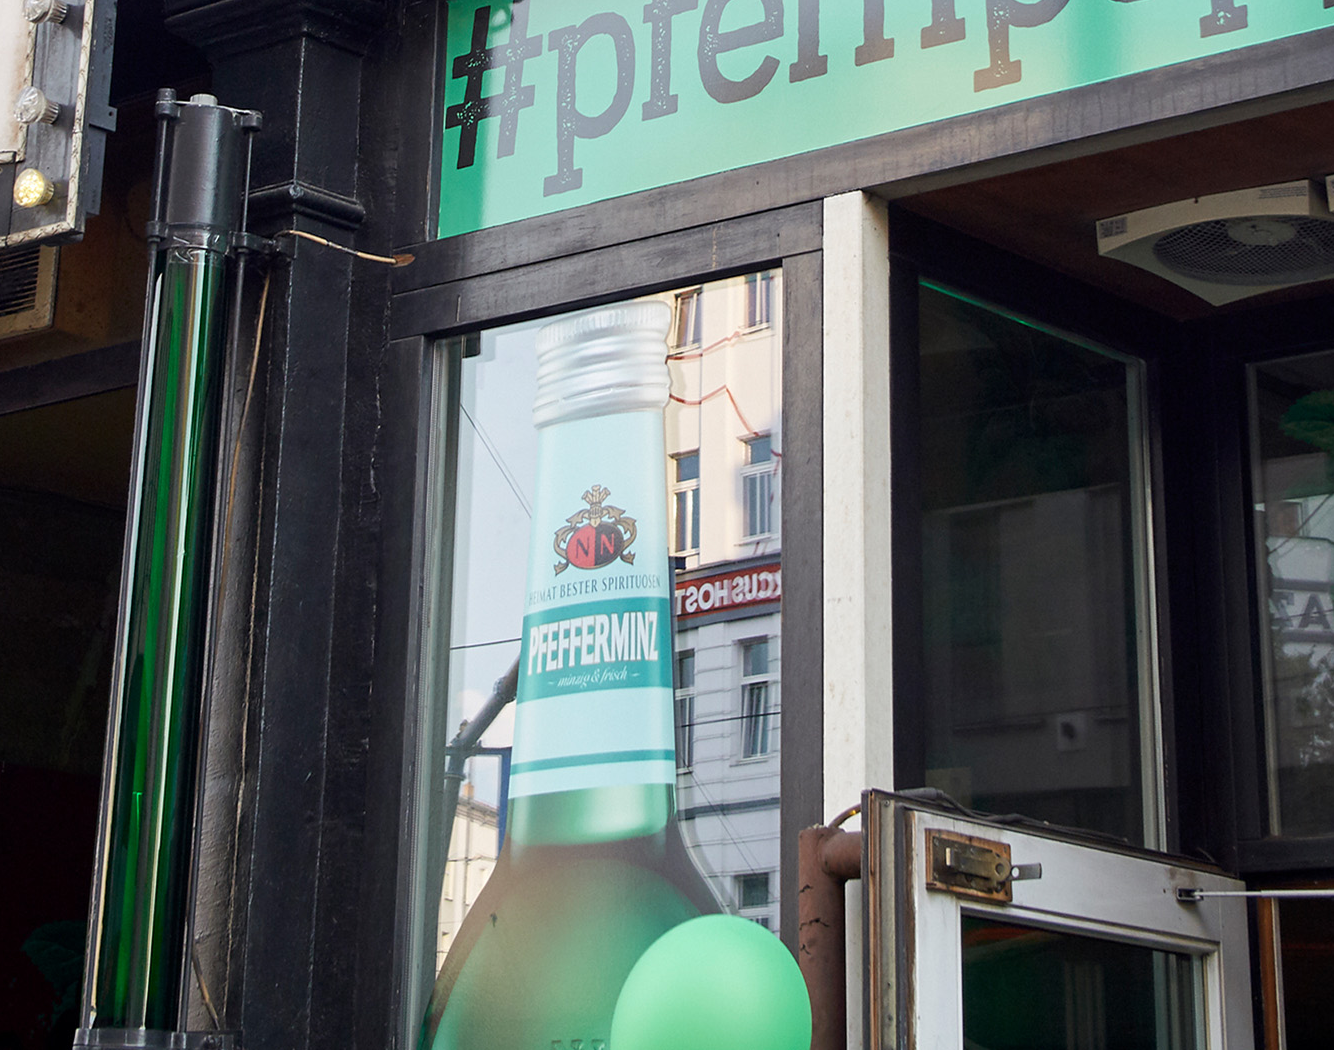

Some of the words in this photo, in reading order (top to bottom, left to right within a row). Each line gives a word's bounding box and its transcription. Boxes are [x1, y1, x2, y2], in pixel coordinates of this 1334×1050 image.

[527, 585, 557, 606] HEIMAT
[559, 578, 599, 599] BESTER
[601, 573, 662, 593] SPIRITUOSEN
[526, 610, 660, 677] PFEFFERMINZ
